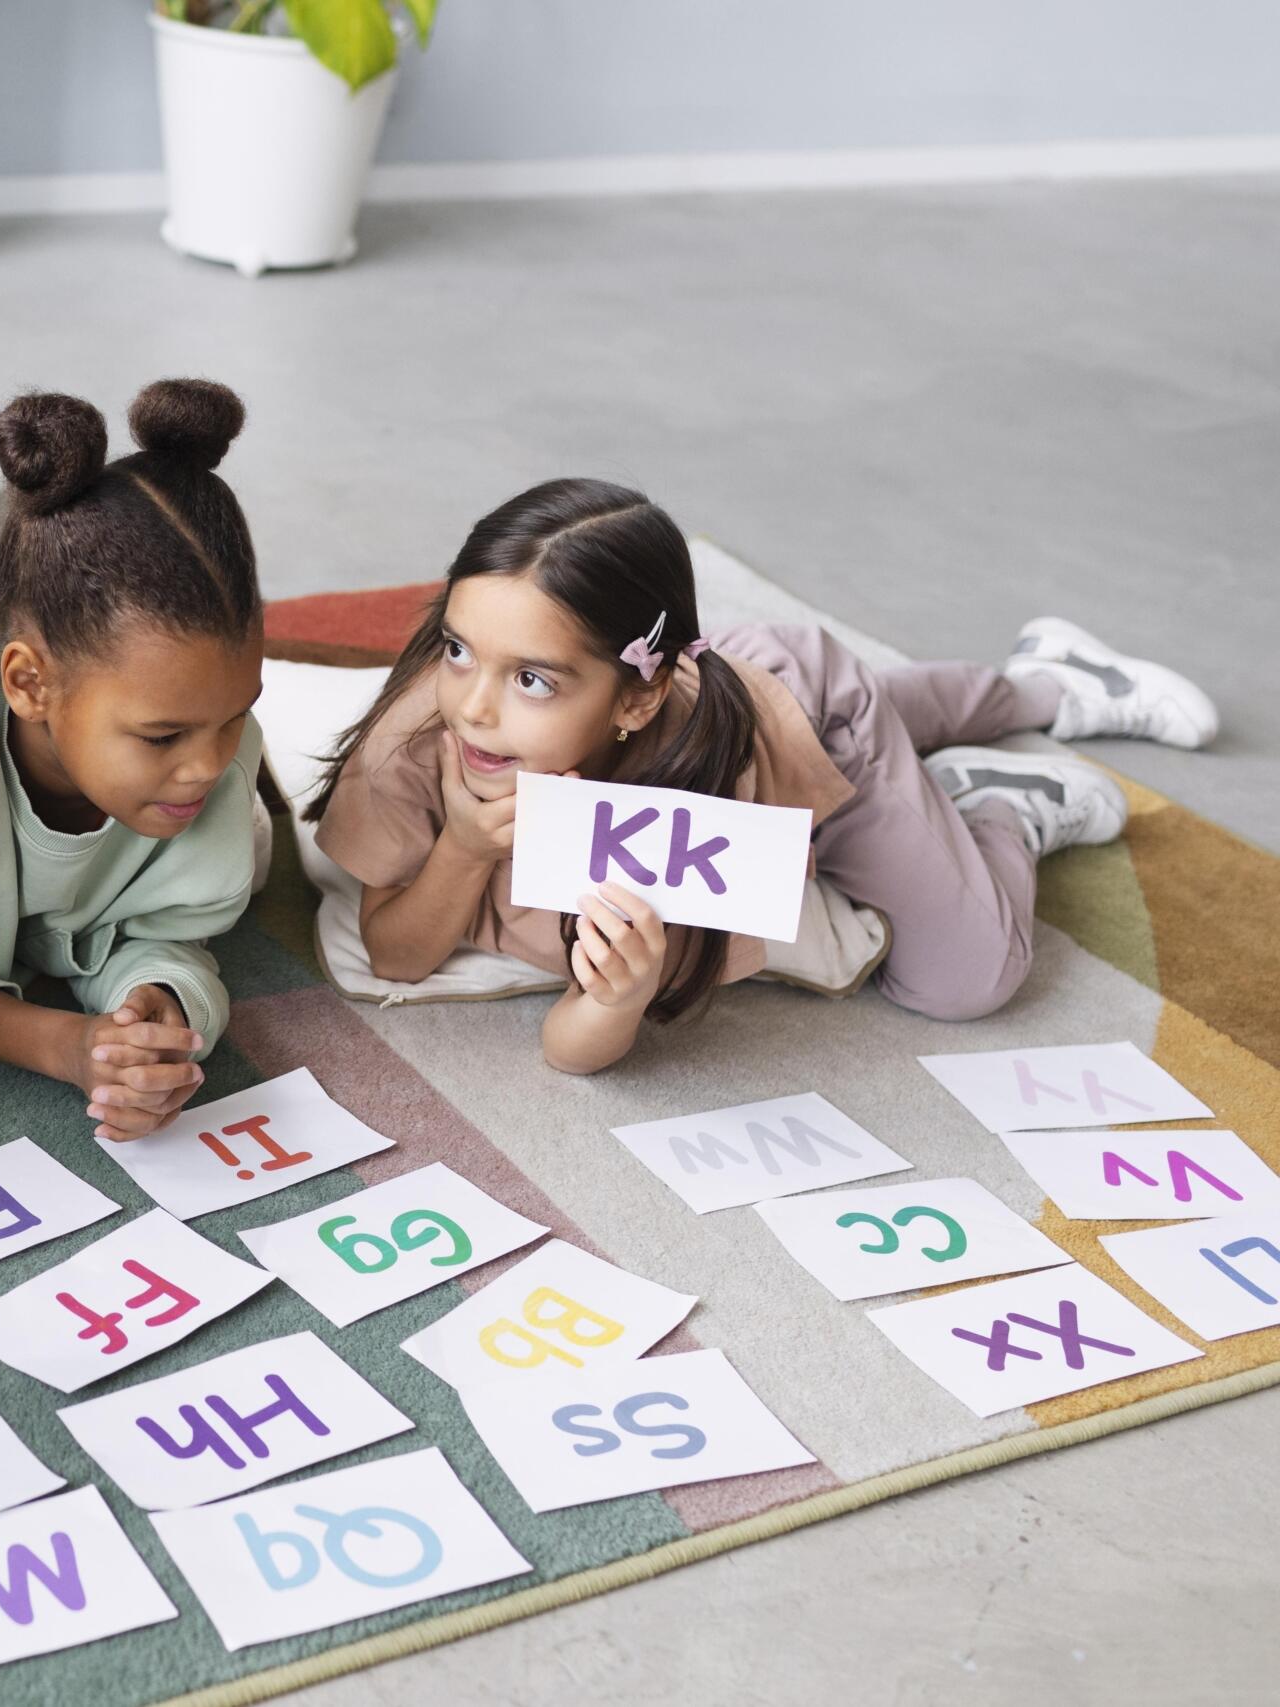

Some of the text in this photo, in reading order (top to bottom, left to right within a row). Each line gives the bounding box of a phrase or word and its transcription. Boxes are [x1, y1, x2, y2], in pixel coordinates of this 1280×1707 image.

[589, 801, 731, 895] Kk
[1013, 1059, 1154, 1115] Yy
[197, 1115, 313, 1180] Ii
[668, 1116, 863, 1176] Ww
[1102, 1150, 1244, 1202] Vv
[317, 1209, 473, 1274] Gg
[836, 1206, 968, 1263] Cc
[55, 1259, 200, 1355] Ff
[477, 1286, 625, 1369] Bb
[951, 1300, 1136, 1371] Xx
[135, 1374, 331, 1470] Hh
[551, 1391, 707, 1460] Ss
[234, 1504, 443, 1590] Qq
